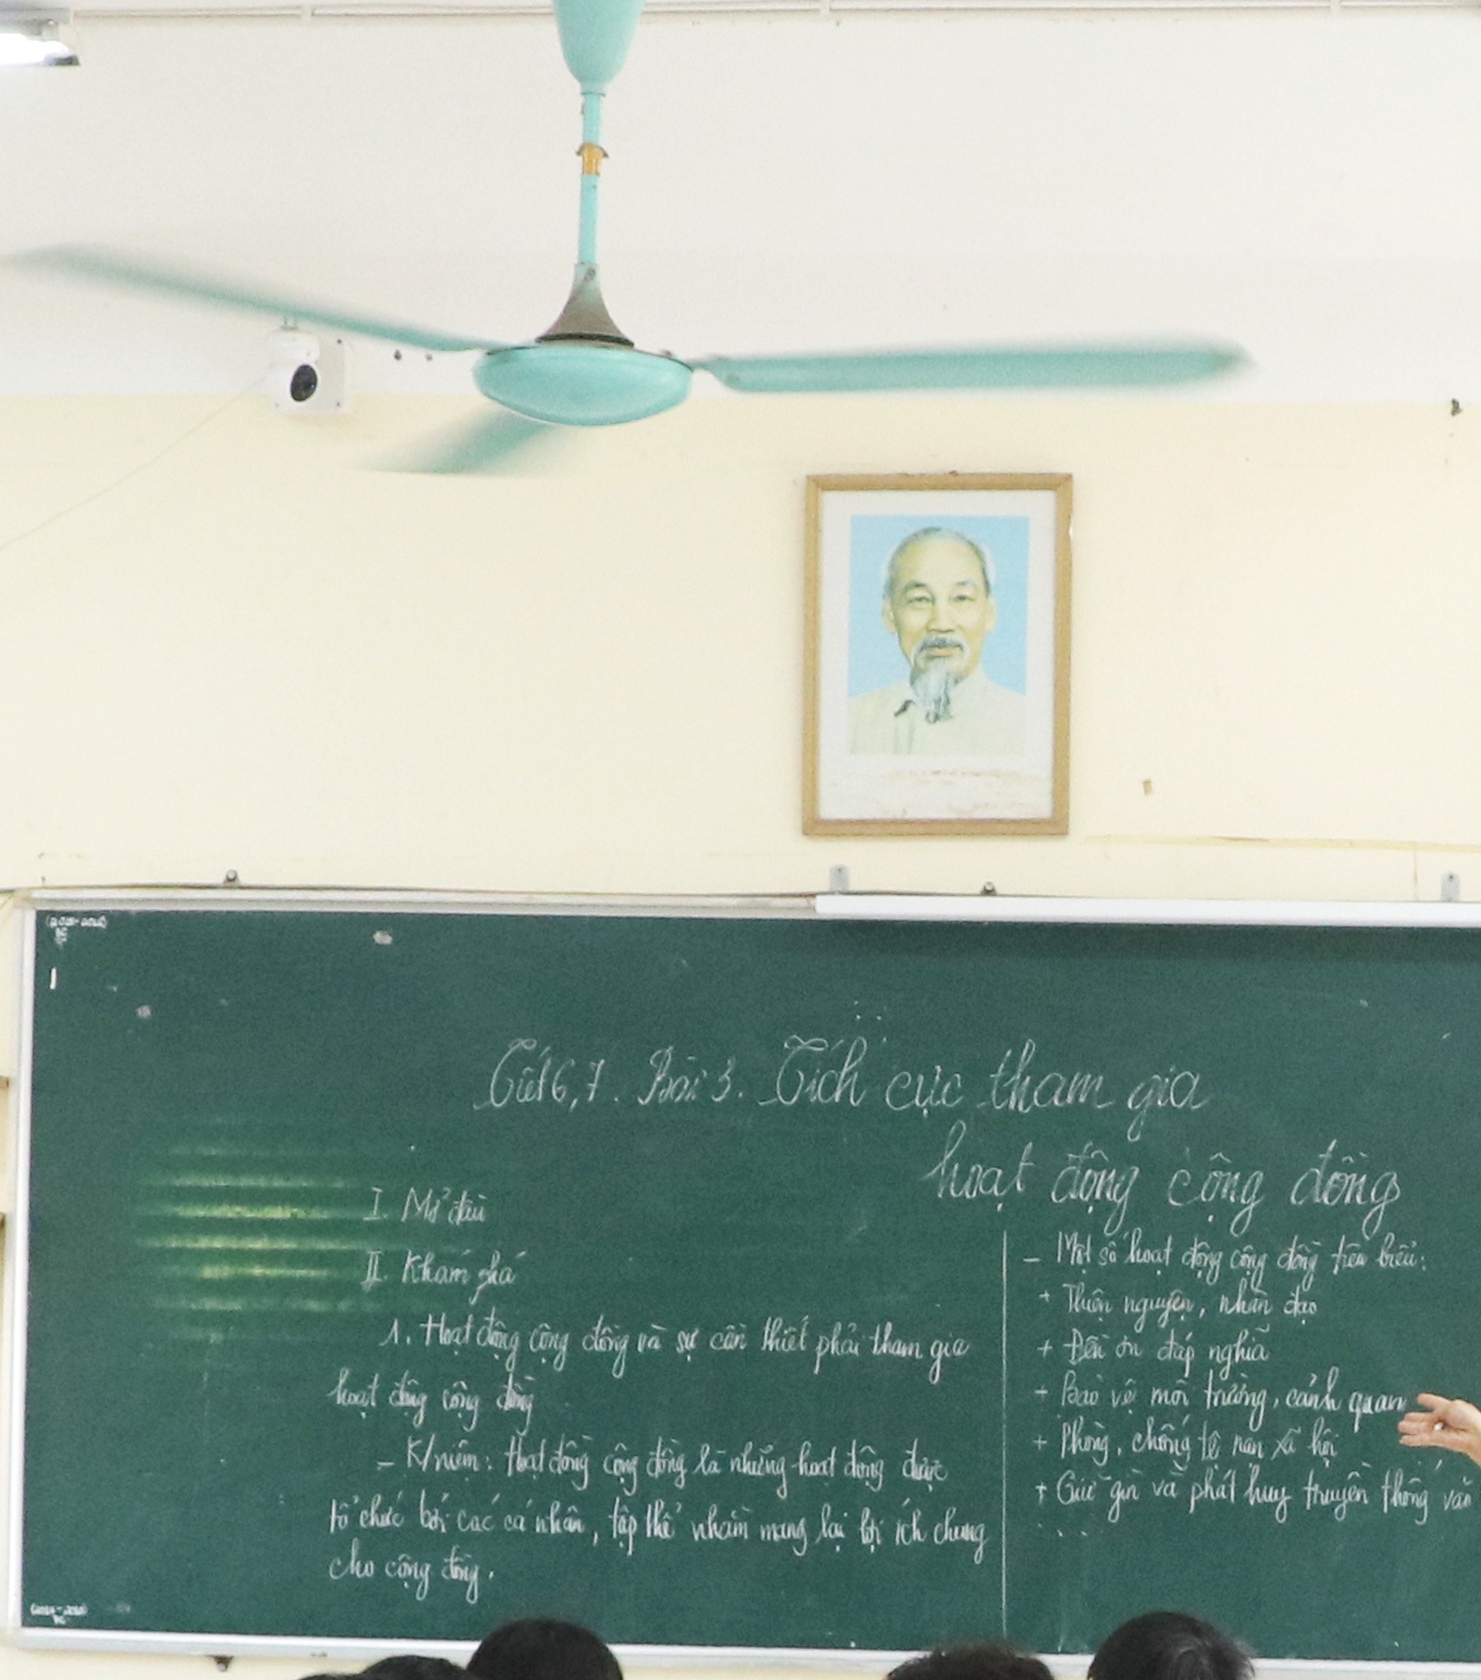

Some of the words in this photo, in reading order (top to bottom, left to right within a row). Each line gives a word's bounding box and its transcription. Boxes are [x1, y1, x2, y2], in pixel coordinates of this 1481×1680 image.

[759, 1035, 868, 1108] Tích
[885, 1065, 964, 1118] cực
[977, 1038, 1116, 1112] tham
[1127, 1066, 1209, 1142] gia
[920, 1119, 1036, 1211] hoạt
[1051, 1141, 1141, 1237] động
[1168, 1150, 1265, 1238] cộng
[1289, 1138, 1402, 1240] đồng
[363, 1186, 388, 1221] I.
[401, 1186, 452, 1224] Mở
[360, 1250, 388, 1287] II.
[401, 1249, 472, 1284] Khám
[1124, 1227, 1173, 1276] hoạt
[1283, 1285, 1318, 1325] đạo
[379, 1318, 412, 1347] 1.
[419, 1312, 474, 1356] Hoạt
[637, 1323, 668, 1352] và
[814, 1321, 860, 1374] phải
[871, 1321, 923, 1359] tham
[928, 1331, 971, 1384] gia
[1157, 1329, 1195, 1378] đáp
[327, 1367, 380, 1419] hoạt
[1349, 1391, 1407, 1433] quan
[1271, 1426, 1301, 1461] xã
[1189, 1465, 1237, 1514] phát
[457, 1493, 501, 1532] các
[933, 1506, 990, 1565] chung
[329, 1537, 376, 1580] cho
